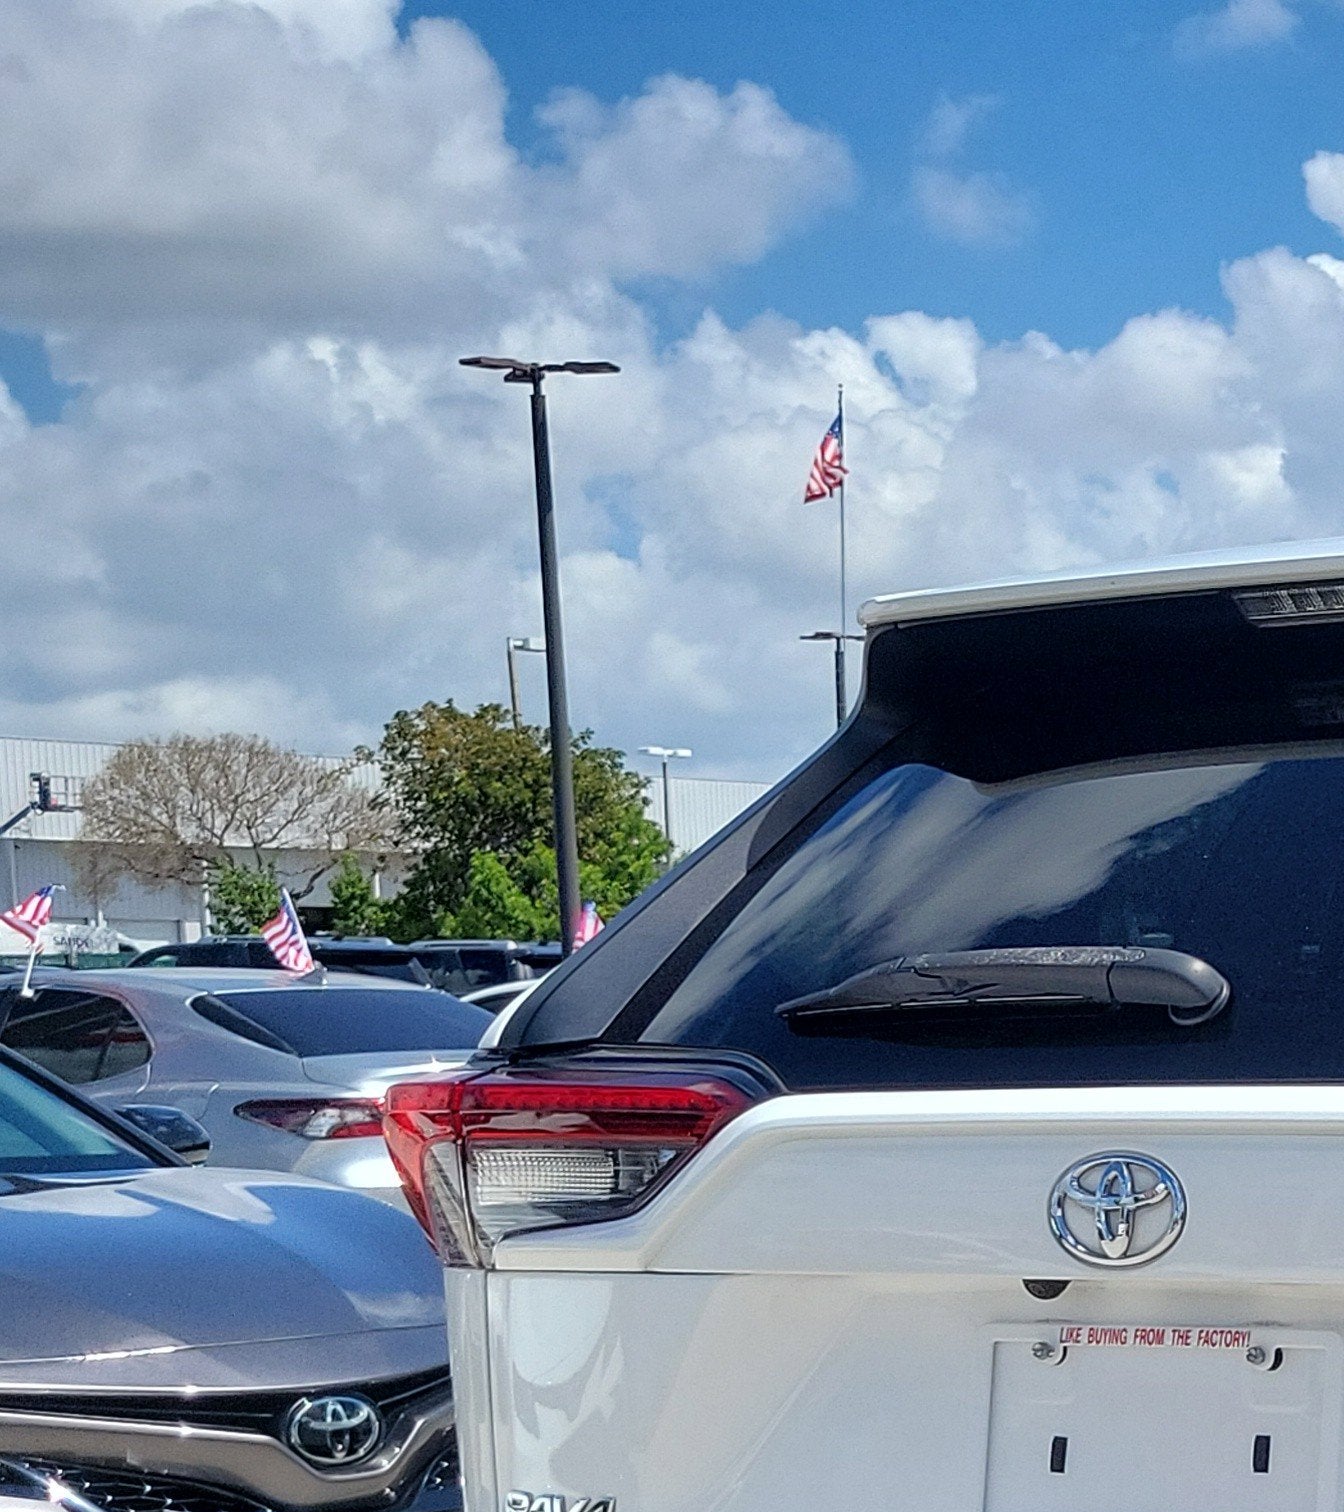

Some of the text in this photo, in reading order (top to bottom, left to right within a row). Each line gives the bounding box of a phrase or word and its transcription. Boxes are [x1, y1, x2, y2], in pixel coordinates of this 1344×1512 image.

[1059, 1326, 1252, 1348] LIKE BUYING FROM THE FACTORY!
